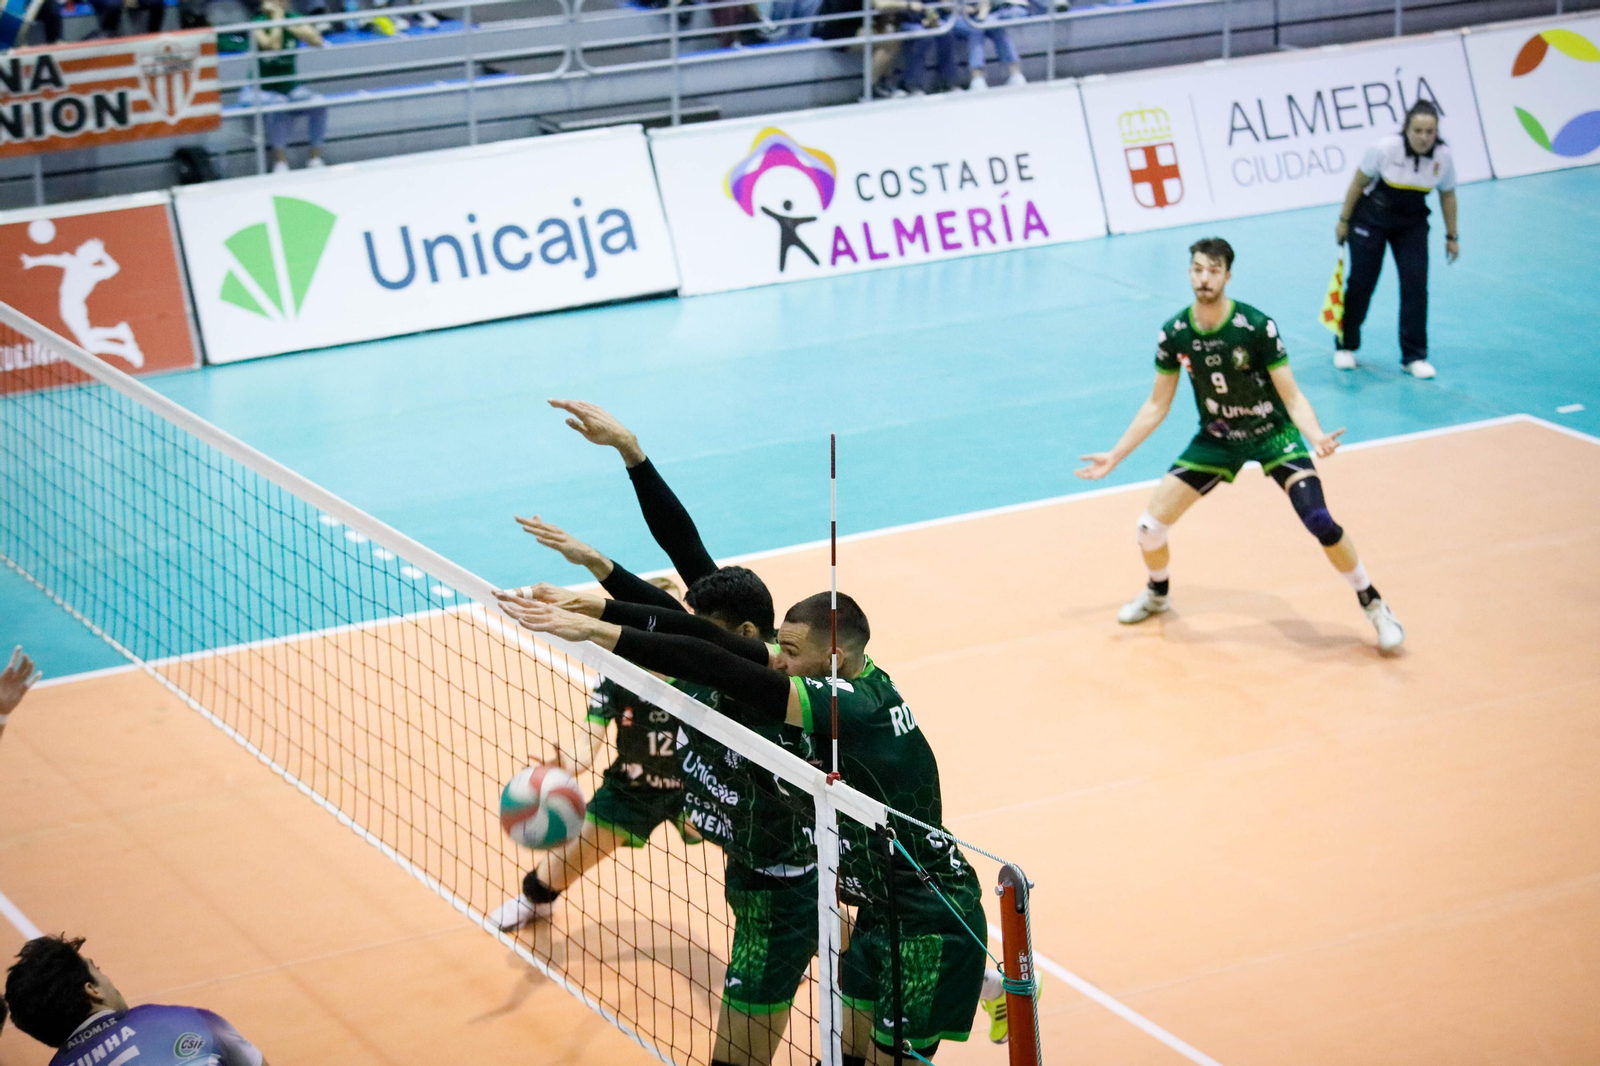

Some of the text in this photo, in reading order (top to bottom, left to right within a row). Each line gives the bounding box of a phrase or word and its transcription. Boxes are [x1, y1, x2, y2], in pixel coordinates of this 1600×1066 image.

[1228, 68, 1445, 145] ALMERÍA
[856, 153, 1034, 200] COSTA DE
[1231, 144, 1346, 187] CIUDAD
[364, 197, 638, 290] Unicaja
[831, 191, 1049, 266] ALMERÍA
[1211, 371, 1229, 394] 9
[647, 731, 674, 757] 12
[67, 1025, 137, 1066] UNHA
[181, 1039, 205, 1050] CSIF
